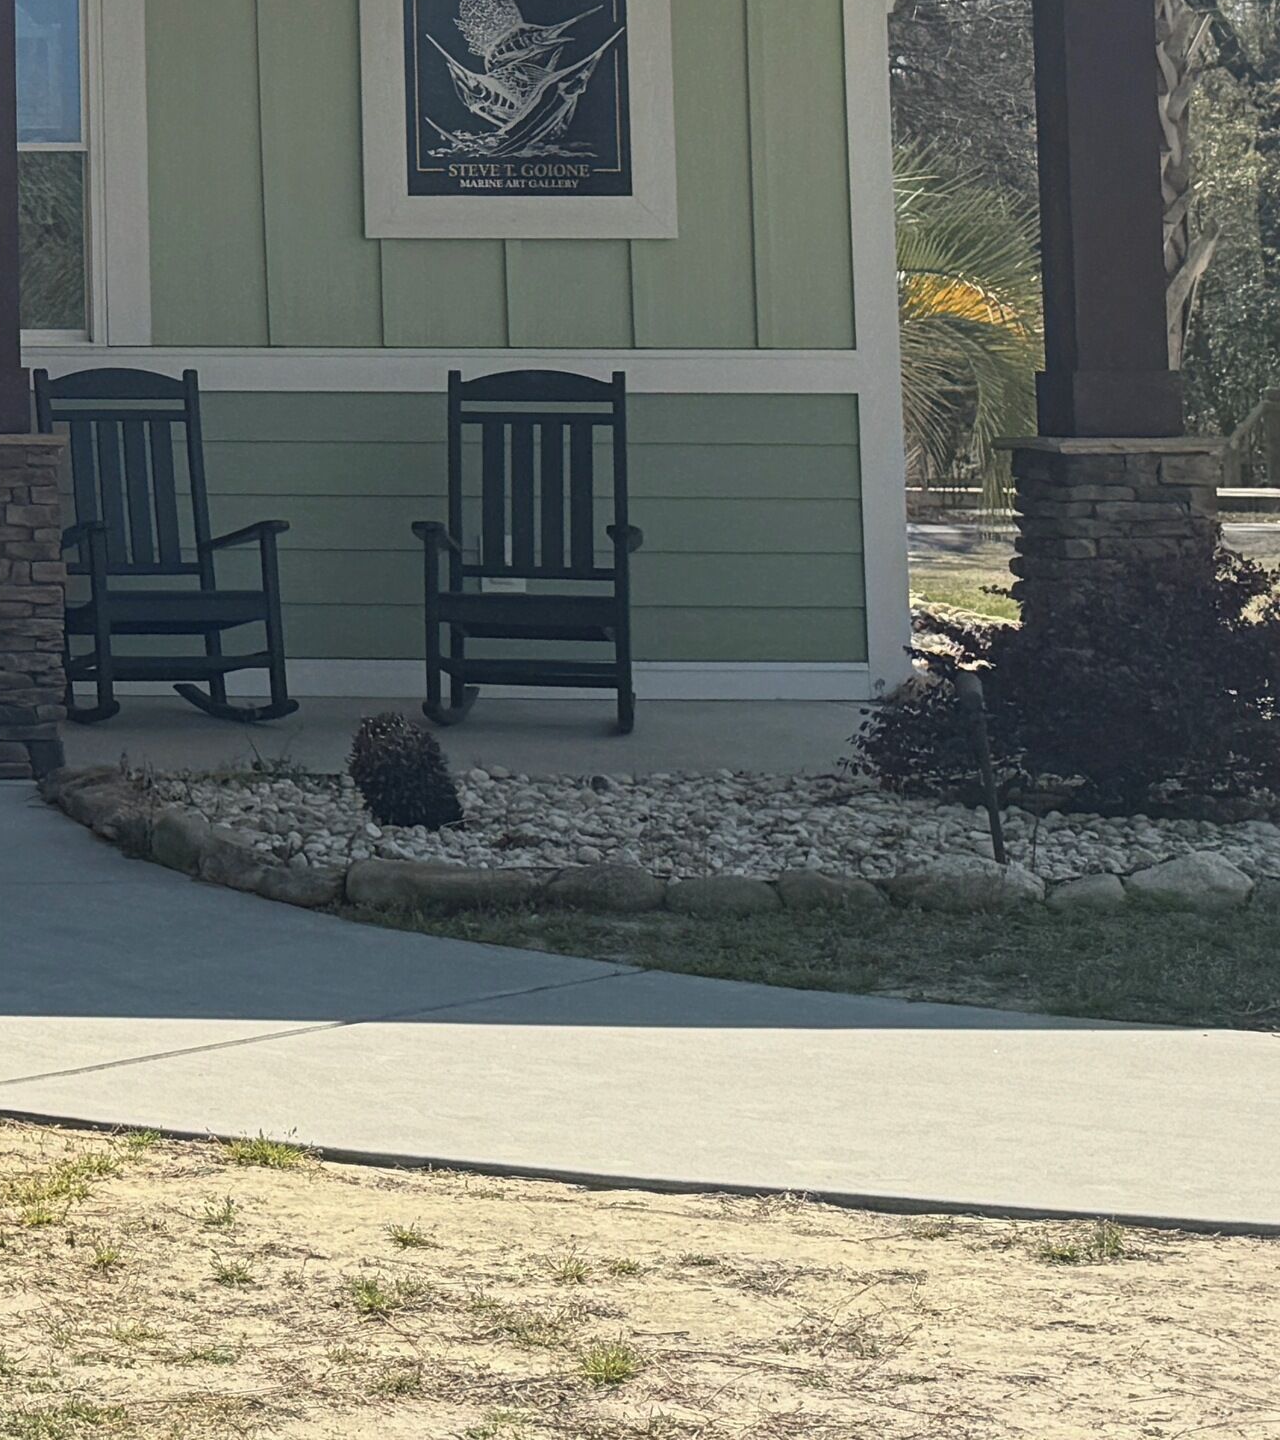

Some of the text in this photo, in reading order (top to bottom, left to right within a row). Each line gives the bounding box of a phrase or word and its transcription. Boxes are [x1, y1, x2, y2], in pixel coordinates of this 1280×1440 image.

[448, 163, 590, 178] STEVE T. GOIONE
[459, 178, 579, 189] MARINE ART GALLERY
